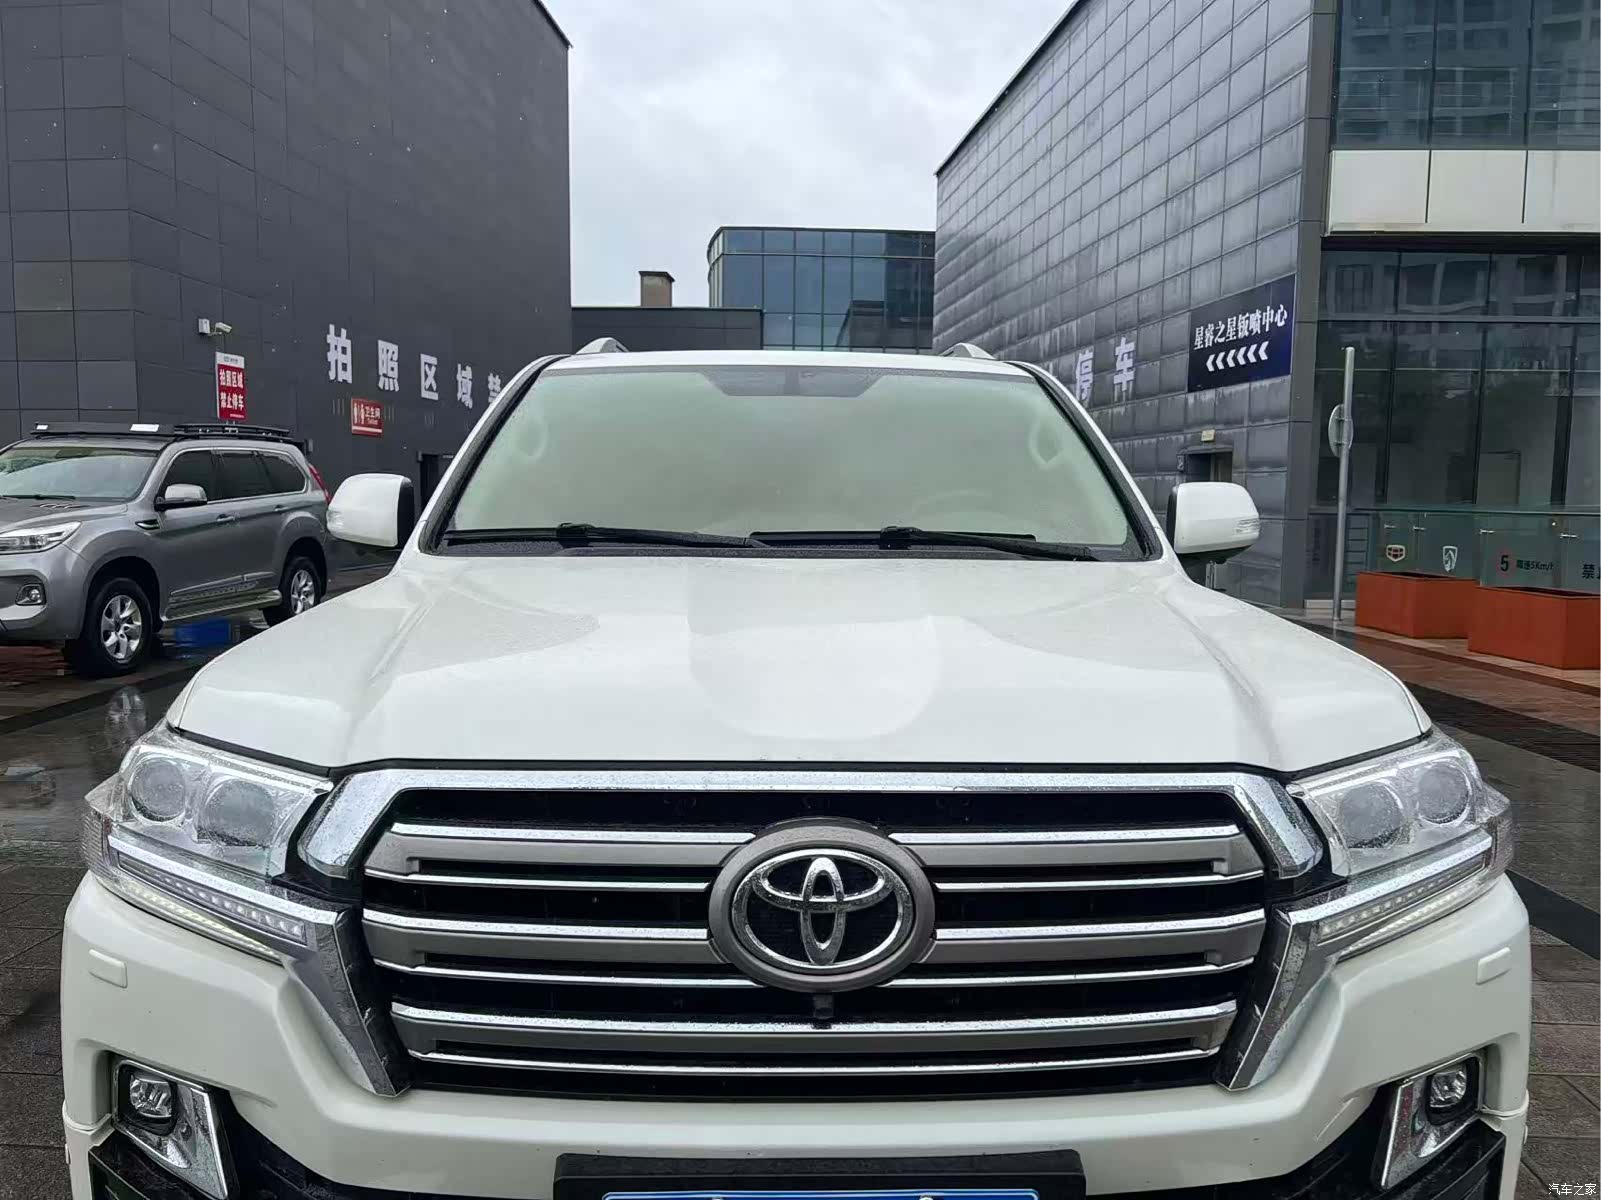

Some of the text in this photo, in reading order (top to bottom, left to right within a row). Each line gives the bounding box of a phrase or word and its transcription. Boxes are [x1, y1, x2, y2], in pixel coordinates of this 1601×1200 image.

[220, 368, 244, 389] 拍照区域
[220, 391, 245, 411] 禁止停车
[1500, 554, 1509, 572] 5
